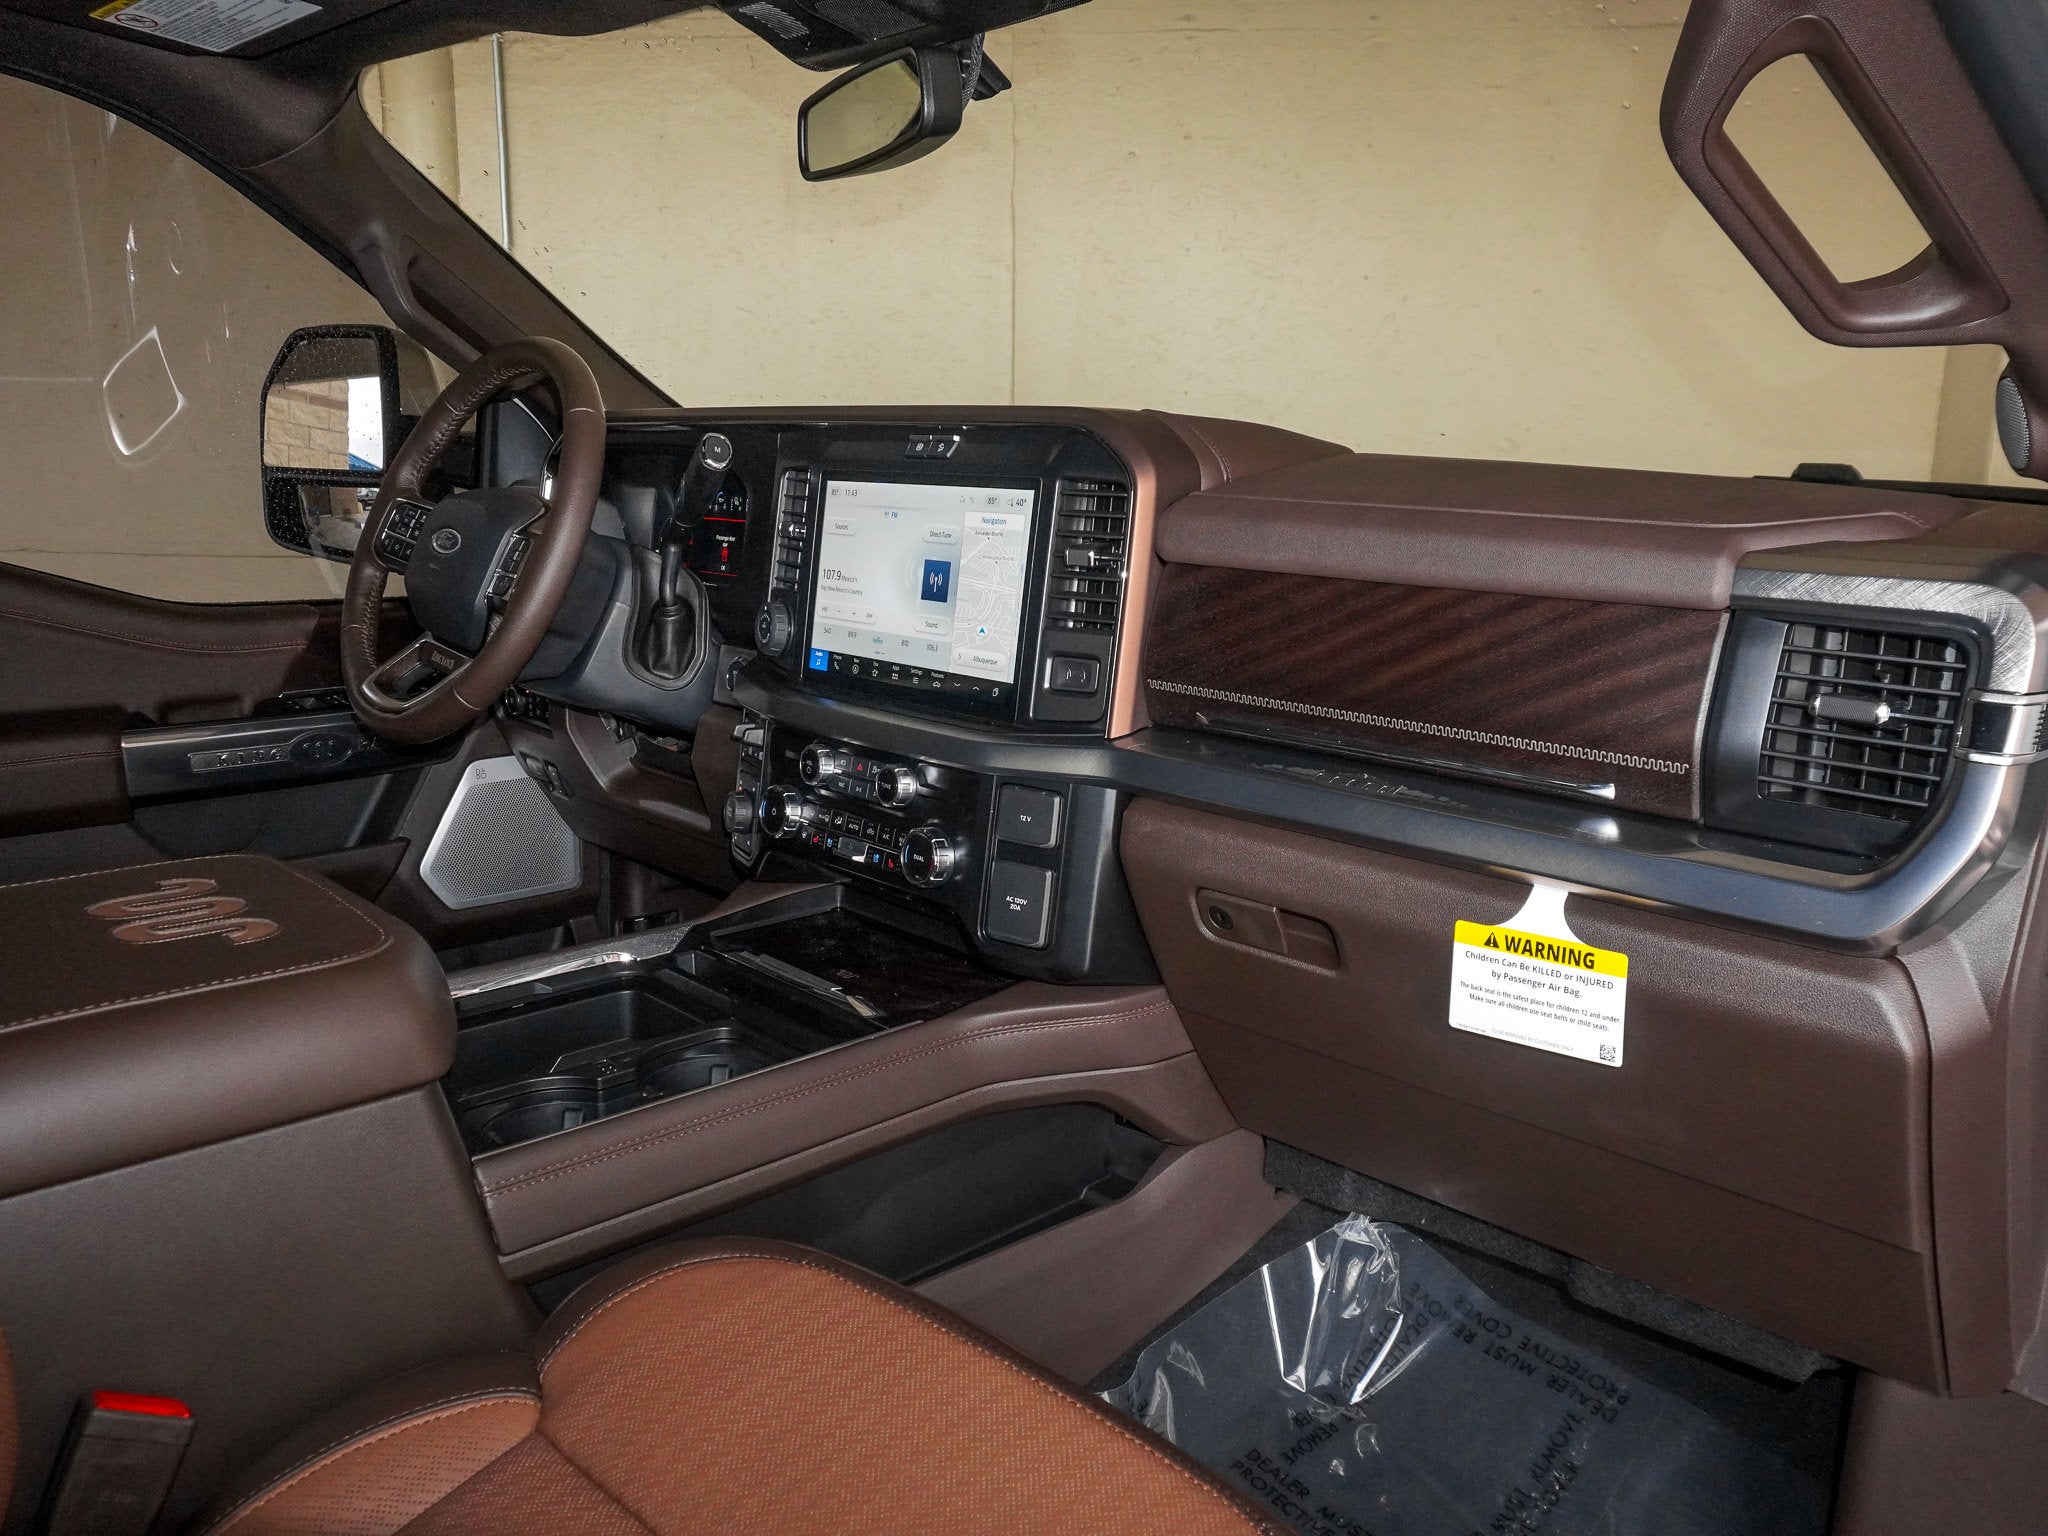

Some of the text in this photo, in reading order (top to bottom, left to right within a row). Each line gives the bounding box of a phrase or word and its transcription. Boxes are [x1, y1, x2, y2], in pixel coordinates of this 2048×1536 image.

[929, 530, 952, 539] Direct Tune
[981, 517, 1007, 525] Navigation
[823, 568, 842, 581] 107.9
[925, 620, 939, 629] Sound
[972, 655, 998, 666] Albuquerque
[848, 822, 859, 831] AUTO
[1009, 903, 1021, 912] 20A
[1014, 897, 1028, 906] 120V
[1504, 934, 1595, 970] WARNING
[1465, 950, 1614, 990] Children Can Be KILLED or INJURED
[1491, 969, 1582, 999] by Passenger Air Bag.
[1460, 980, 1470, 989] The
[1470, 983, 1483, 992] back
[1484, 986, 1496, 995] seat
[1502, 991, 1512, 999] the
[1512, 993, 1529, 1003] safest
[1530, 997, 1545, 1007] place
[1546, 1001, 1555, 1009] for
[1555, 1003, 1580, 1014] children
[1581, 1009, 1588, 1017] 12
[1589, 1011, 1601, 1019] and
[1602, 1015, 1622, 1025] under.
[1469, 993, 1484, 1003] Make
[1505, 1001, 1529, 1013] children
[1529, 1007, 1539, 1015] use
[1540, 1010, 1553, 1018] seat
[1553, 1013, 1568, 1022] belts
[1576, 1019, 1591, 1028] child
[1592, 1022, 1610, 1032] seats.
[1454, 1293, 1632, 1406] PROTECTIVE COVER
[1482, 1341, 1538, 1377] MUST
[1546, 1374, 1619, 1424] DEALER
[1246, 1448, 1311, 1500] DEALER
